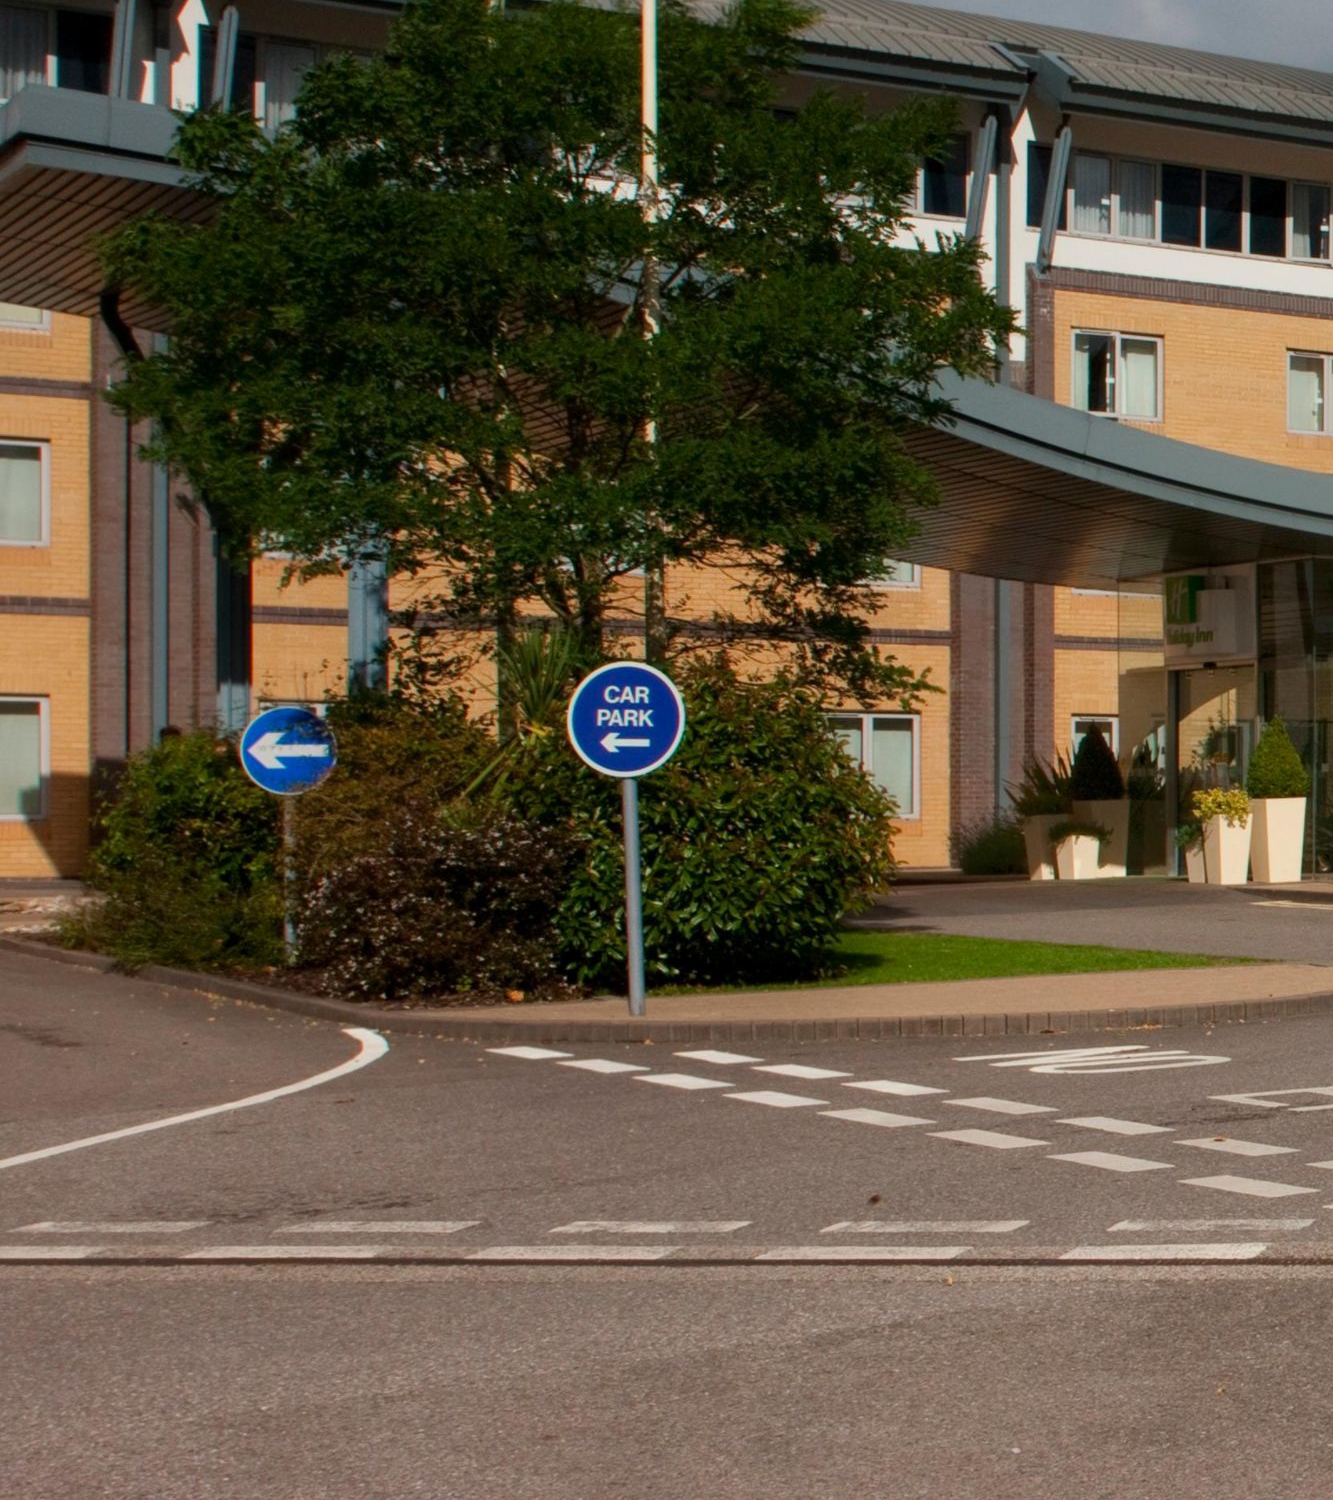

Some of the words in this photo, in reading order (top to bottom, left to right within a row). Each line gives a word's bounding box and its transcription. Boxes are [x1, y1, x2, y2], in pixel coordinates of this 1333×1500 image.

[604, 686, 649, 703] CAR
[596, 709, 653, 726] PARK
[952, 1045, 1231, 1075] NO
